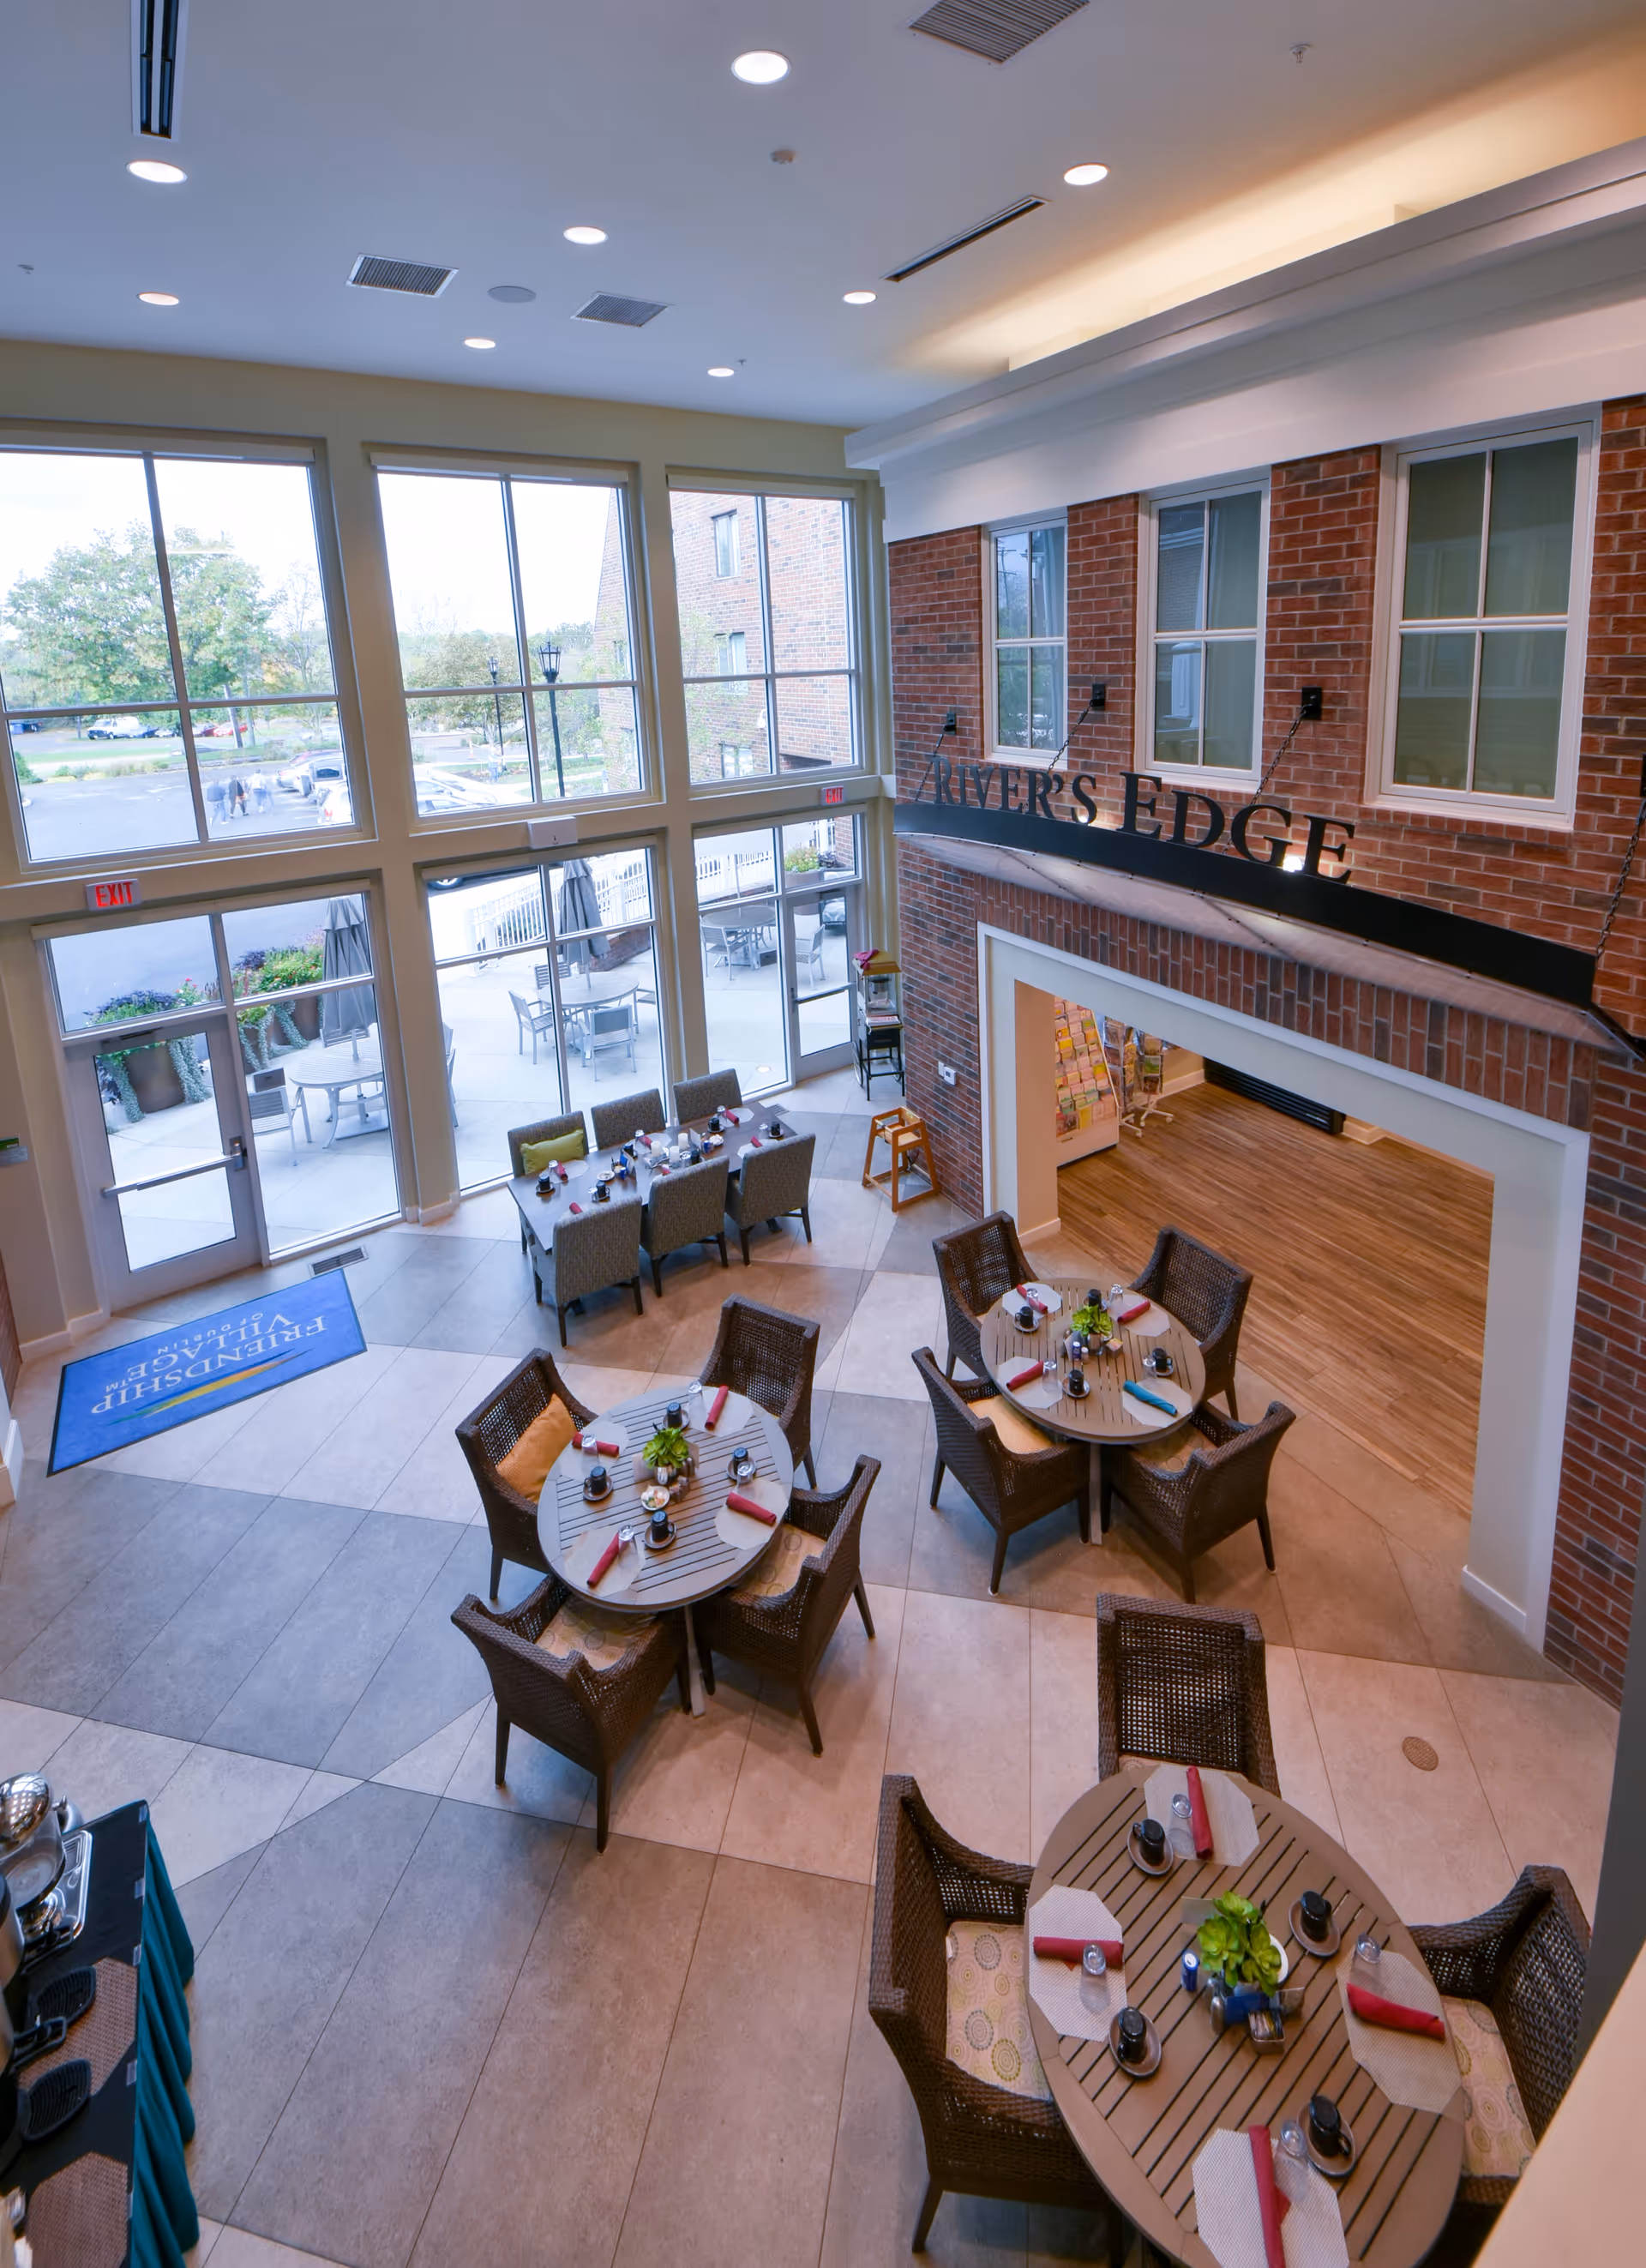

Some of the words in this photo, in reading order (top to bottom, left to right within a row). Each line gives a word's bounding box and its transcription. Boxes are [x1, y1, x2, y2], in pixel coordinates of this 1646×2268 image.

[826, 787, 844, 804] EXIT
[933, 755, 1098, 825] RIVER'S
[1116, 771, 1356, 885] EDGE
[95, 881, 133, 907] EXIT
[239, 1313, 264, 1326] OF
[127, 1314, 295, 1381] VILLAGE
[158, 1324, 231, 1355] DUBLIN
[91, 1315, 328, 1414] FRIENDSHIP
